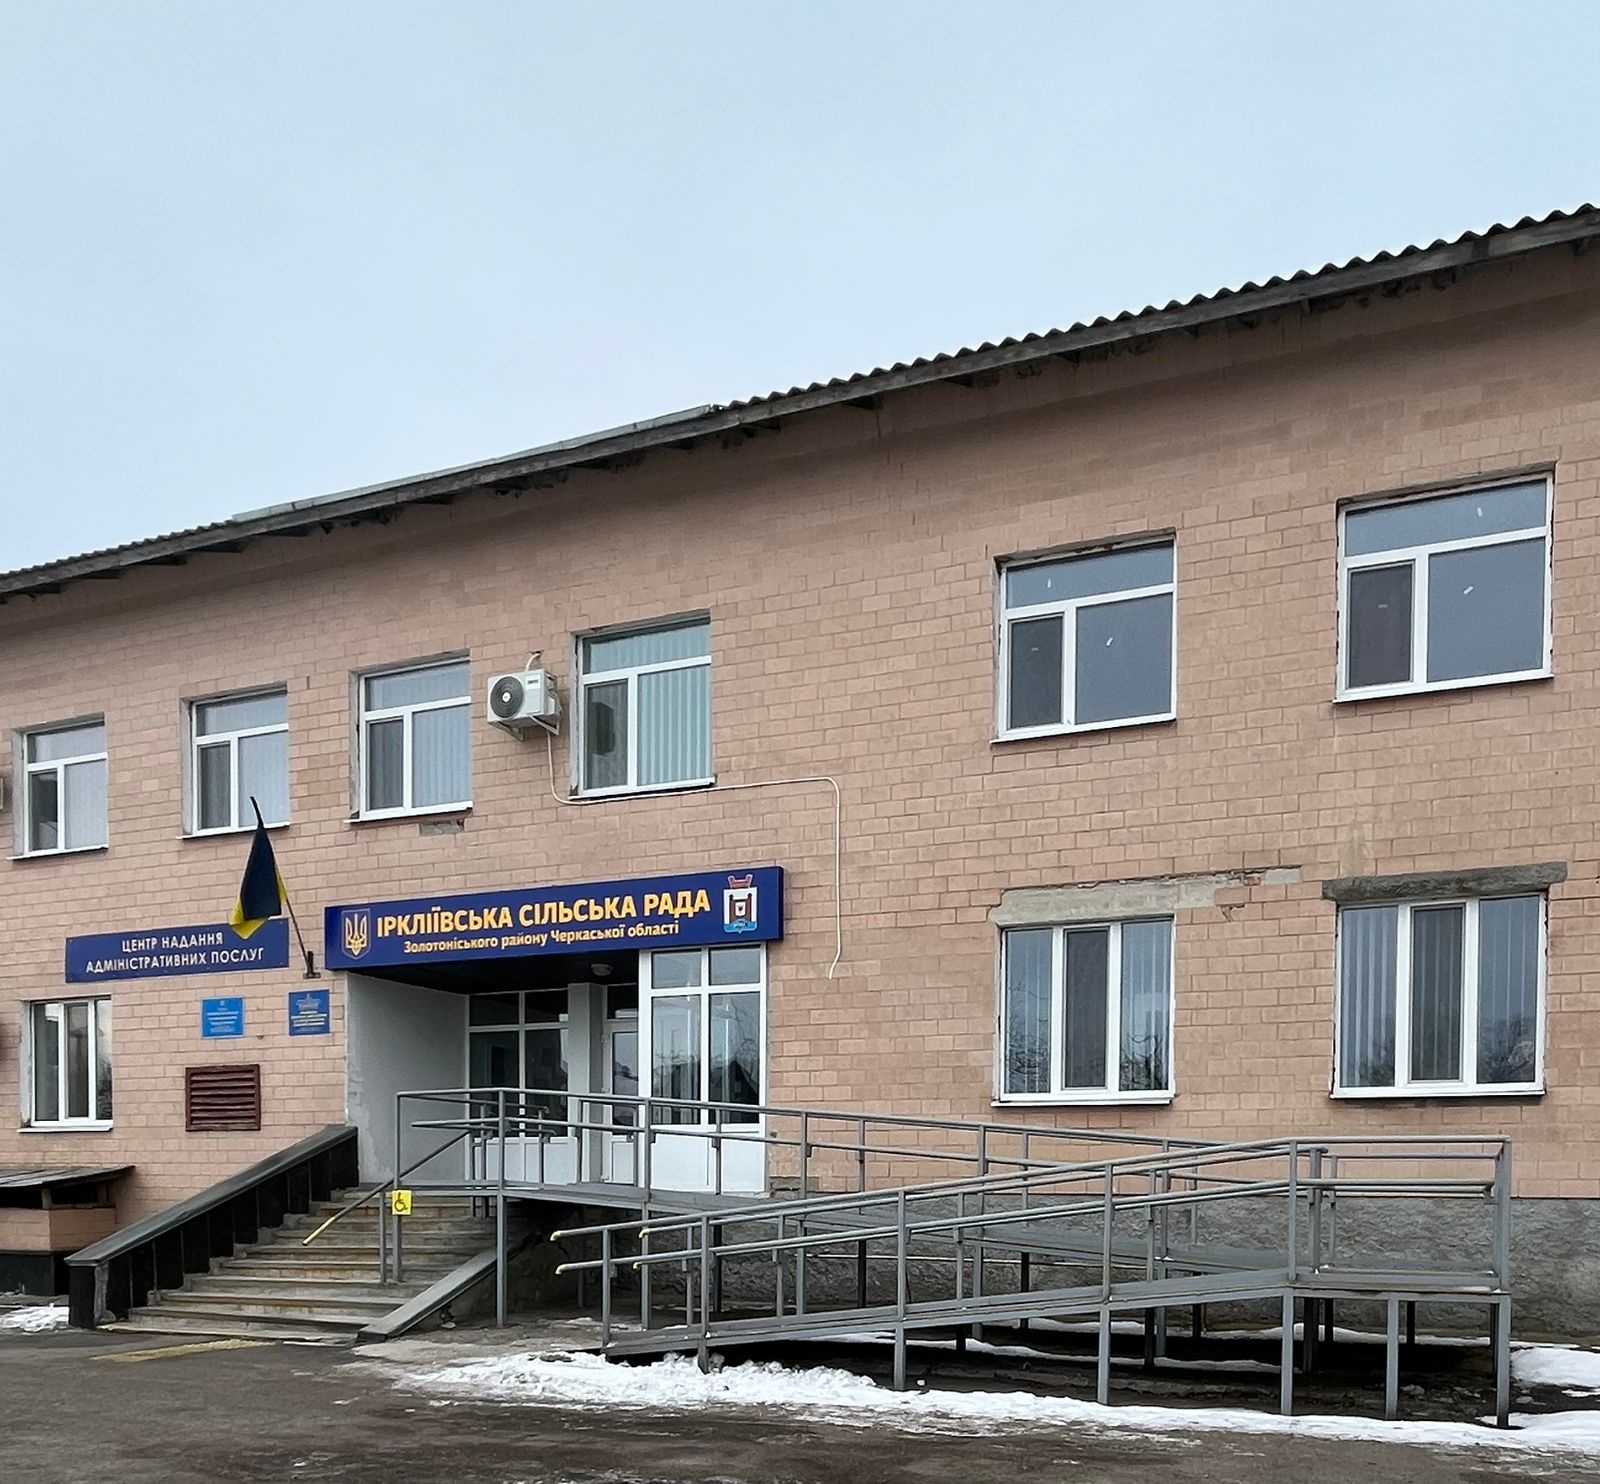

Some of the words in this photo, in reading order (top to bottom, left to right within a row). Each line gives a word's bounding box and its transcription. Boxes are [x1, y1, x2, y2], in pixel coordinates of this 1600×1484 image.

[377, 906, 513, 937] ІРКЛІЇВСЬКА
[519, 896, 636, 926] СІЛЬСЬКА
[644, 889, 711, 918] РАДА
[122, 937, 158, 953] ЦЕНТР
[162, 932, 223, 949] НАДАННЯ
[404, 937, 498, 953] Золотоніського
[501, 932, 548, 949] району
[551, 923, 625, 944] Черкаської
[628, 920, 679, 938] області
[86, 952, 206, 974] АДМІНІСТРАТИВНИХ
[211, 947, 264, 964] ПОСЛУГ
